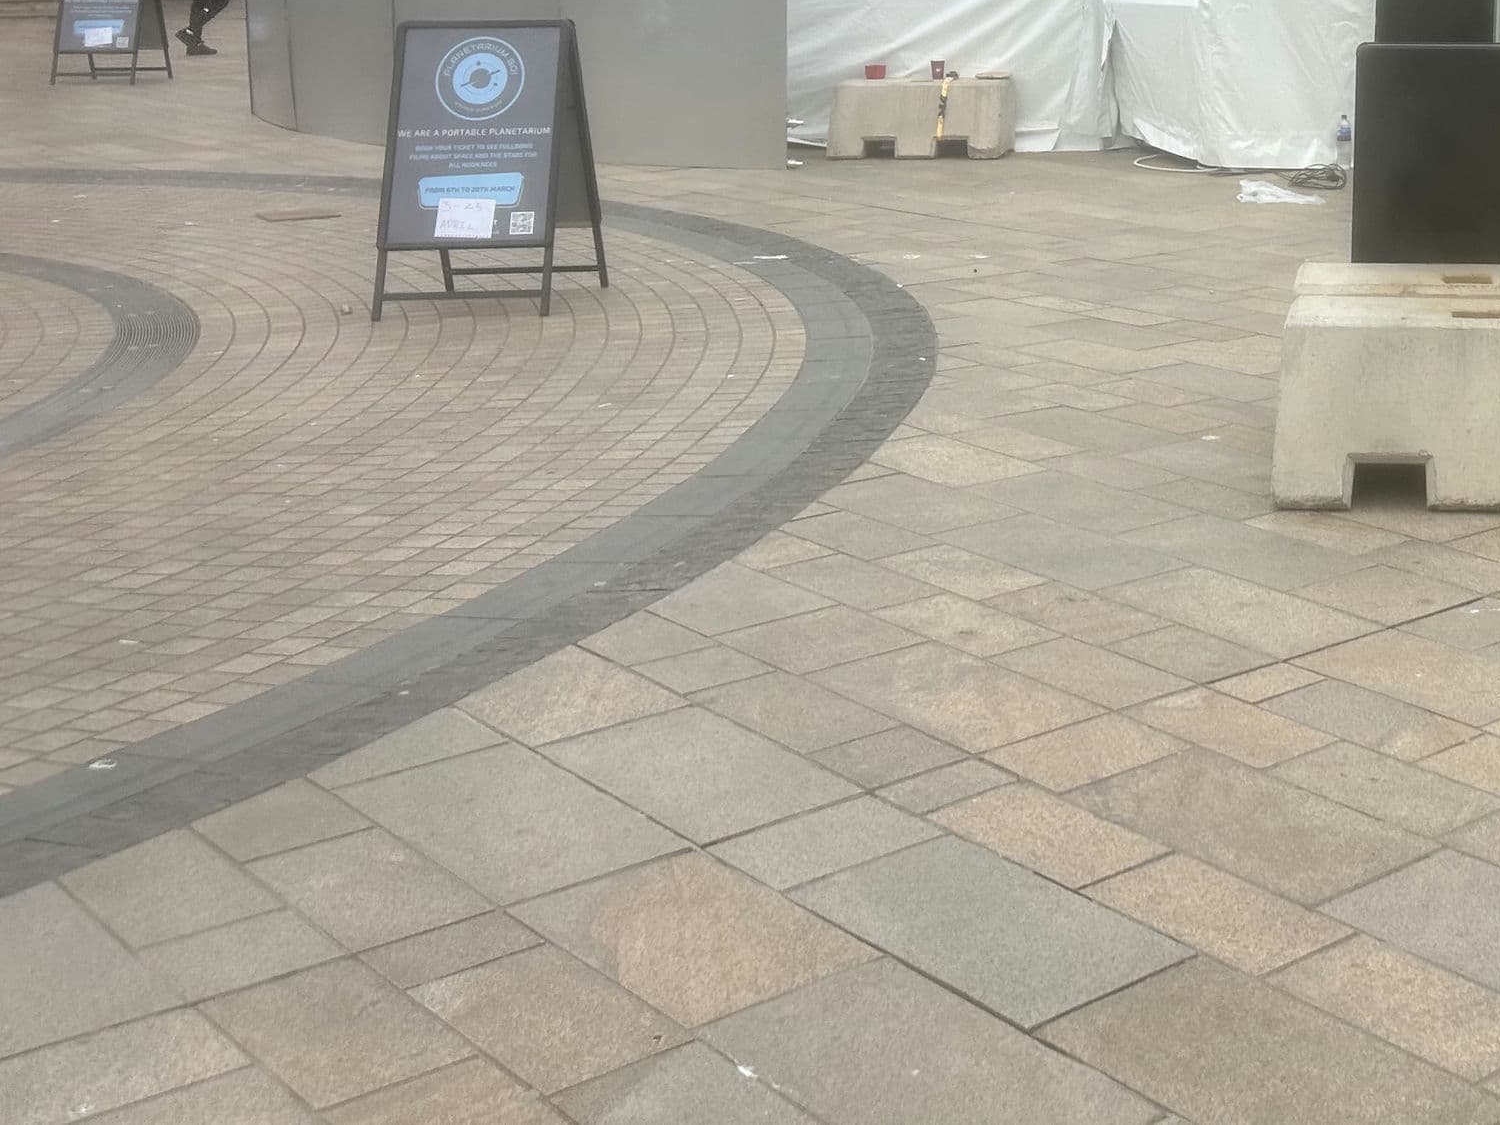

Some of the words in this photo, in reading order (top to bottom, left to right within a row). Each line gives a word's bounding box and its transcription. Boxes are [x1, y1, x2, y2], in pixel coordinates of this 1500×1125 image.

[397, 129, 412, 138] WE
[414, 129, 431, 137] ARE
[433, 129, 440, 137] A
[441, 128, 488, 137] PORTABLE
[489, 126, 551, 136] PLANETARIUM
